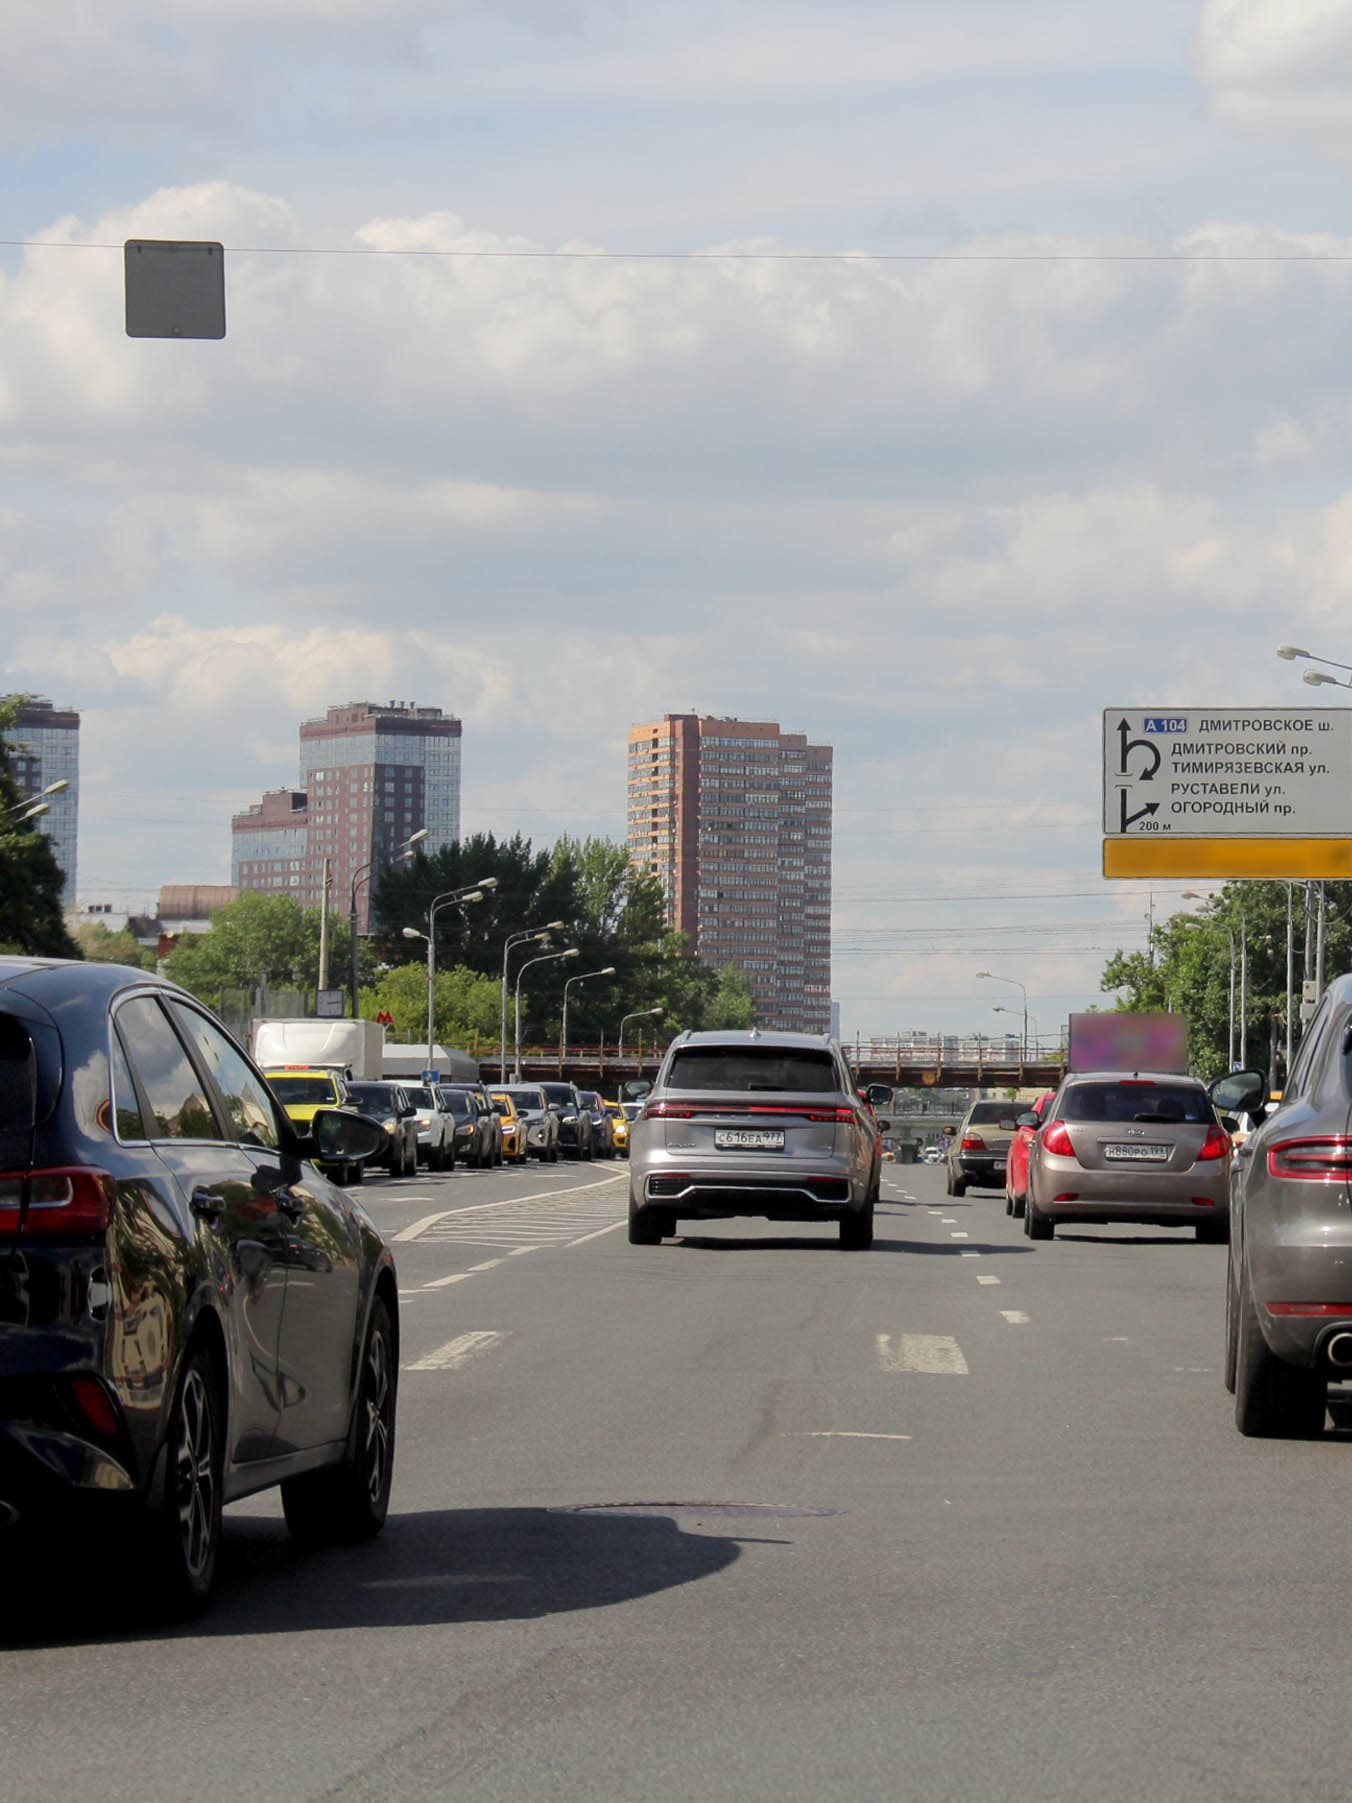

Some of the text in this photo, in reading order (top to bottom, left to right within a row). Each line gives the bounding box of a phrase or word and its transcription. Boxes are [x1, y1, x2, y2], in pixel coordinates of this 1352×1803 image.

[1163, 719, 1185, 732] 104
[1200, 719, 1334, 732] ДМИТРОВСКОЕ ш.
[1171, 741, 1312, 757] ДМИТРОВСКИЙ пр.
[1172, 761, 1330, 776] ТИМИРЯЗЕВСКАЯ ул.
[1171, 783, 1286, 797] РУСТАВЕЛИ ул.
[1171, 799, 1295, 816] ОГОРОДНЫЙ пр.
[1139, 821, 1171, 831] 200 м
